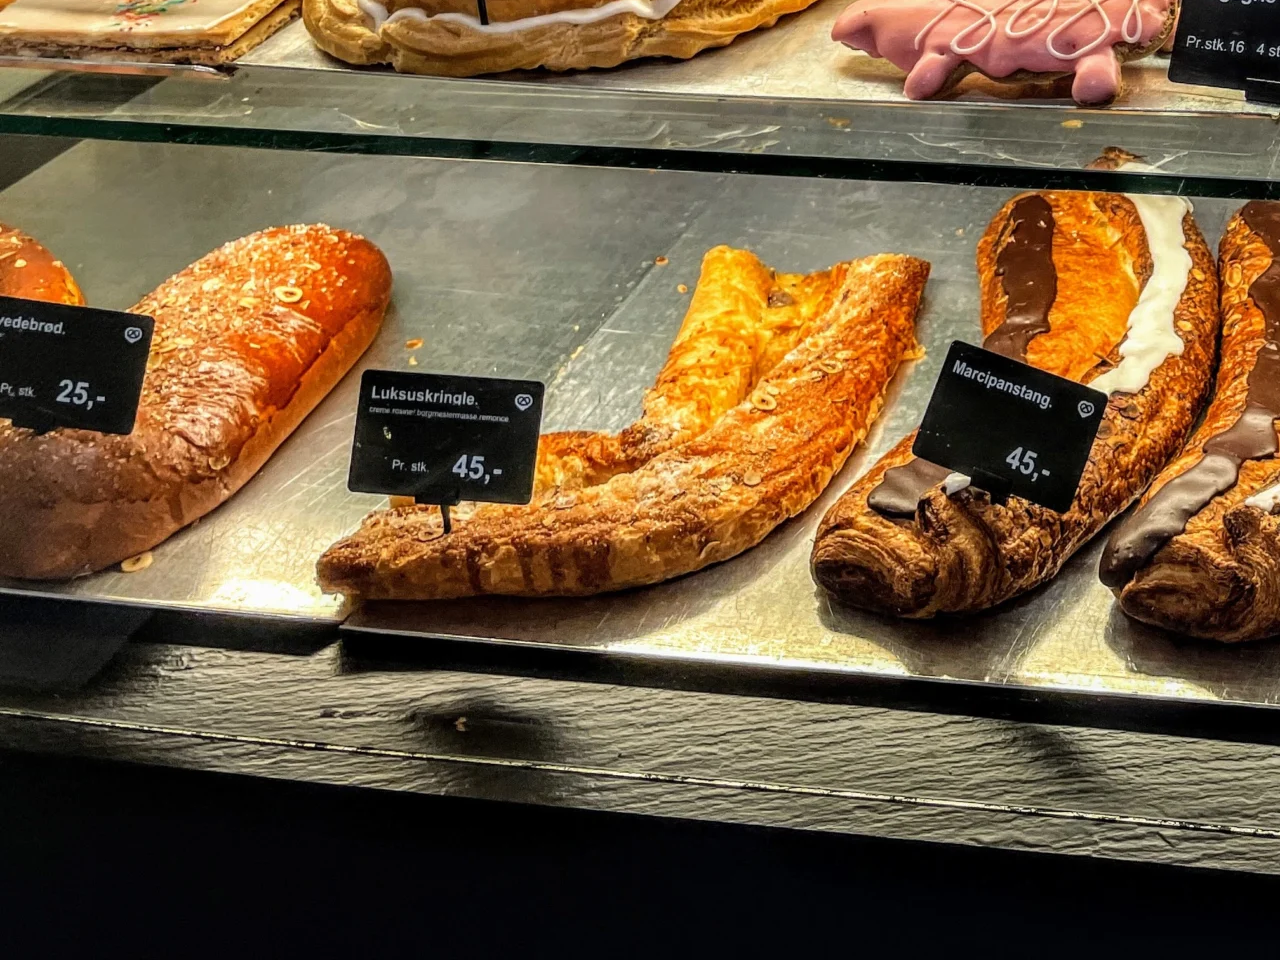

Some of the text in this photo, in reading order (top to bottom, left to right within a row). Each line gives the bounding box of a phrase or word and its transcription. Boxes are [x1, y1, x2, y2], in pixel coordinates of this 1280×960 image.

[1186, 35, 1245, 54] Pr.stk.16
[1256, 43, 1265, 56] 4
[56, 379, 106, 410] 25,-
[371, 385, 479, 407] Luksuskringle.
[952, 359, 1053, 409] Marcipanstang.
[392, 454, 503, 485] Pr. stk. 45,-
[1005, 446, 1051, 482] 45,-
